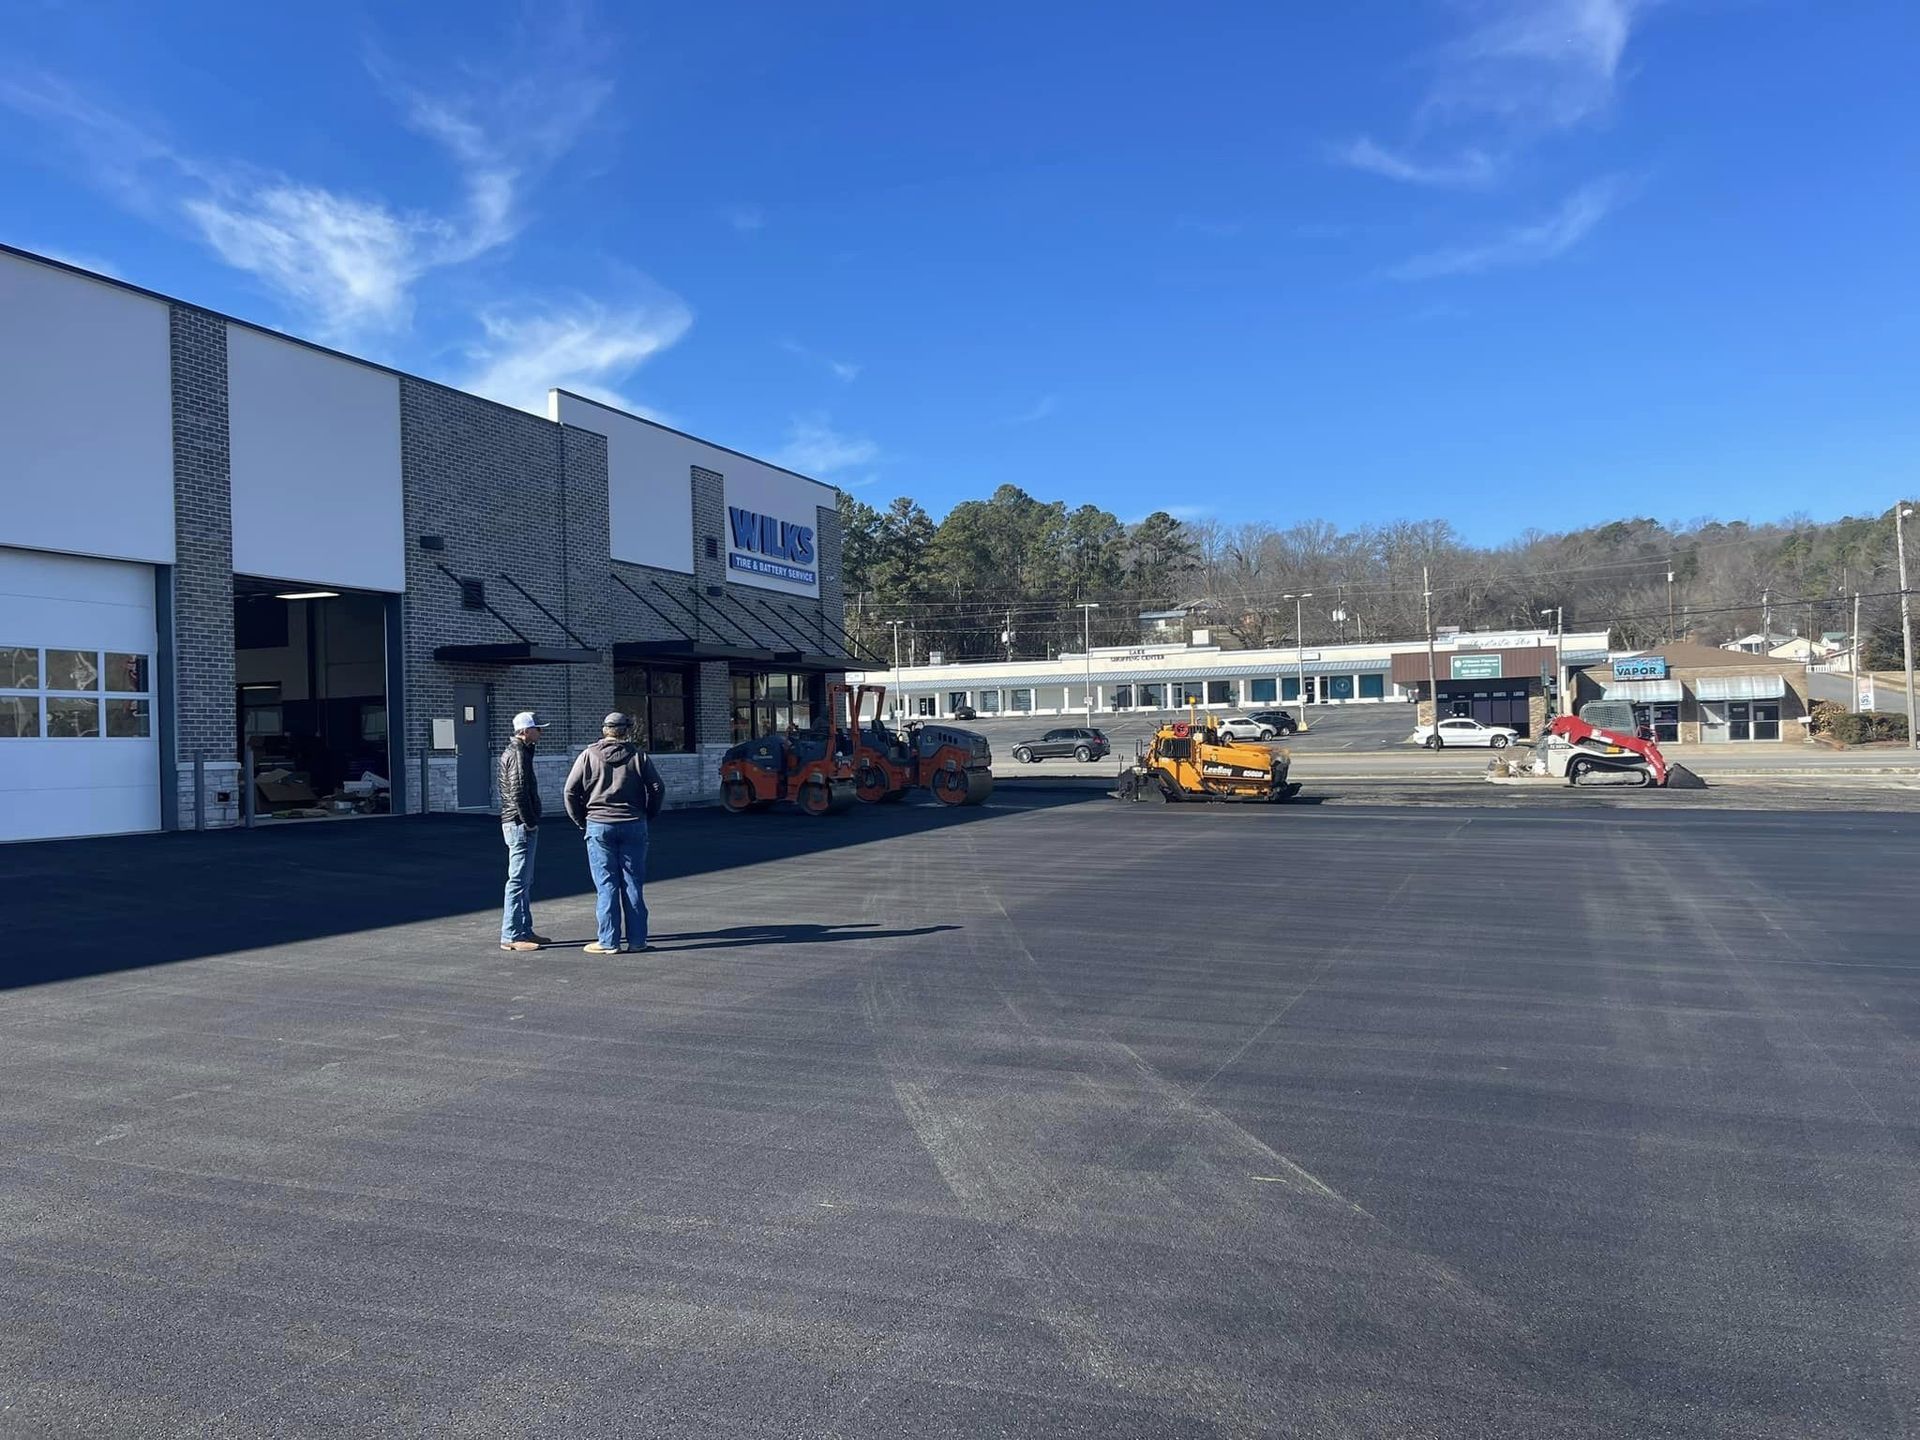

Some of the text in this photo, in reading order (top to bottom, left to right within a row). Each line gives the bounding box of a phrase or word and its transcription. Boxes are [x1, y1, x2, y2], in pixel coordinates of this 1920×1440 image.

[728, 506, 814, 565] WILKS
[735, 556, 814, 582] TIRE & BATTERY SERVICE
[1110, 654, 1165, 663] SHOPPING CENTER
[1616, 666, 1657, 676] VAPOR
